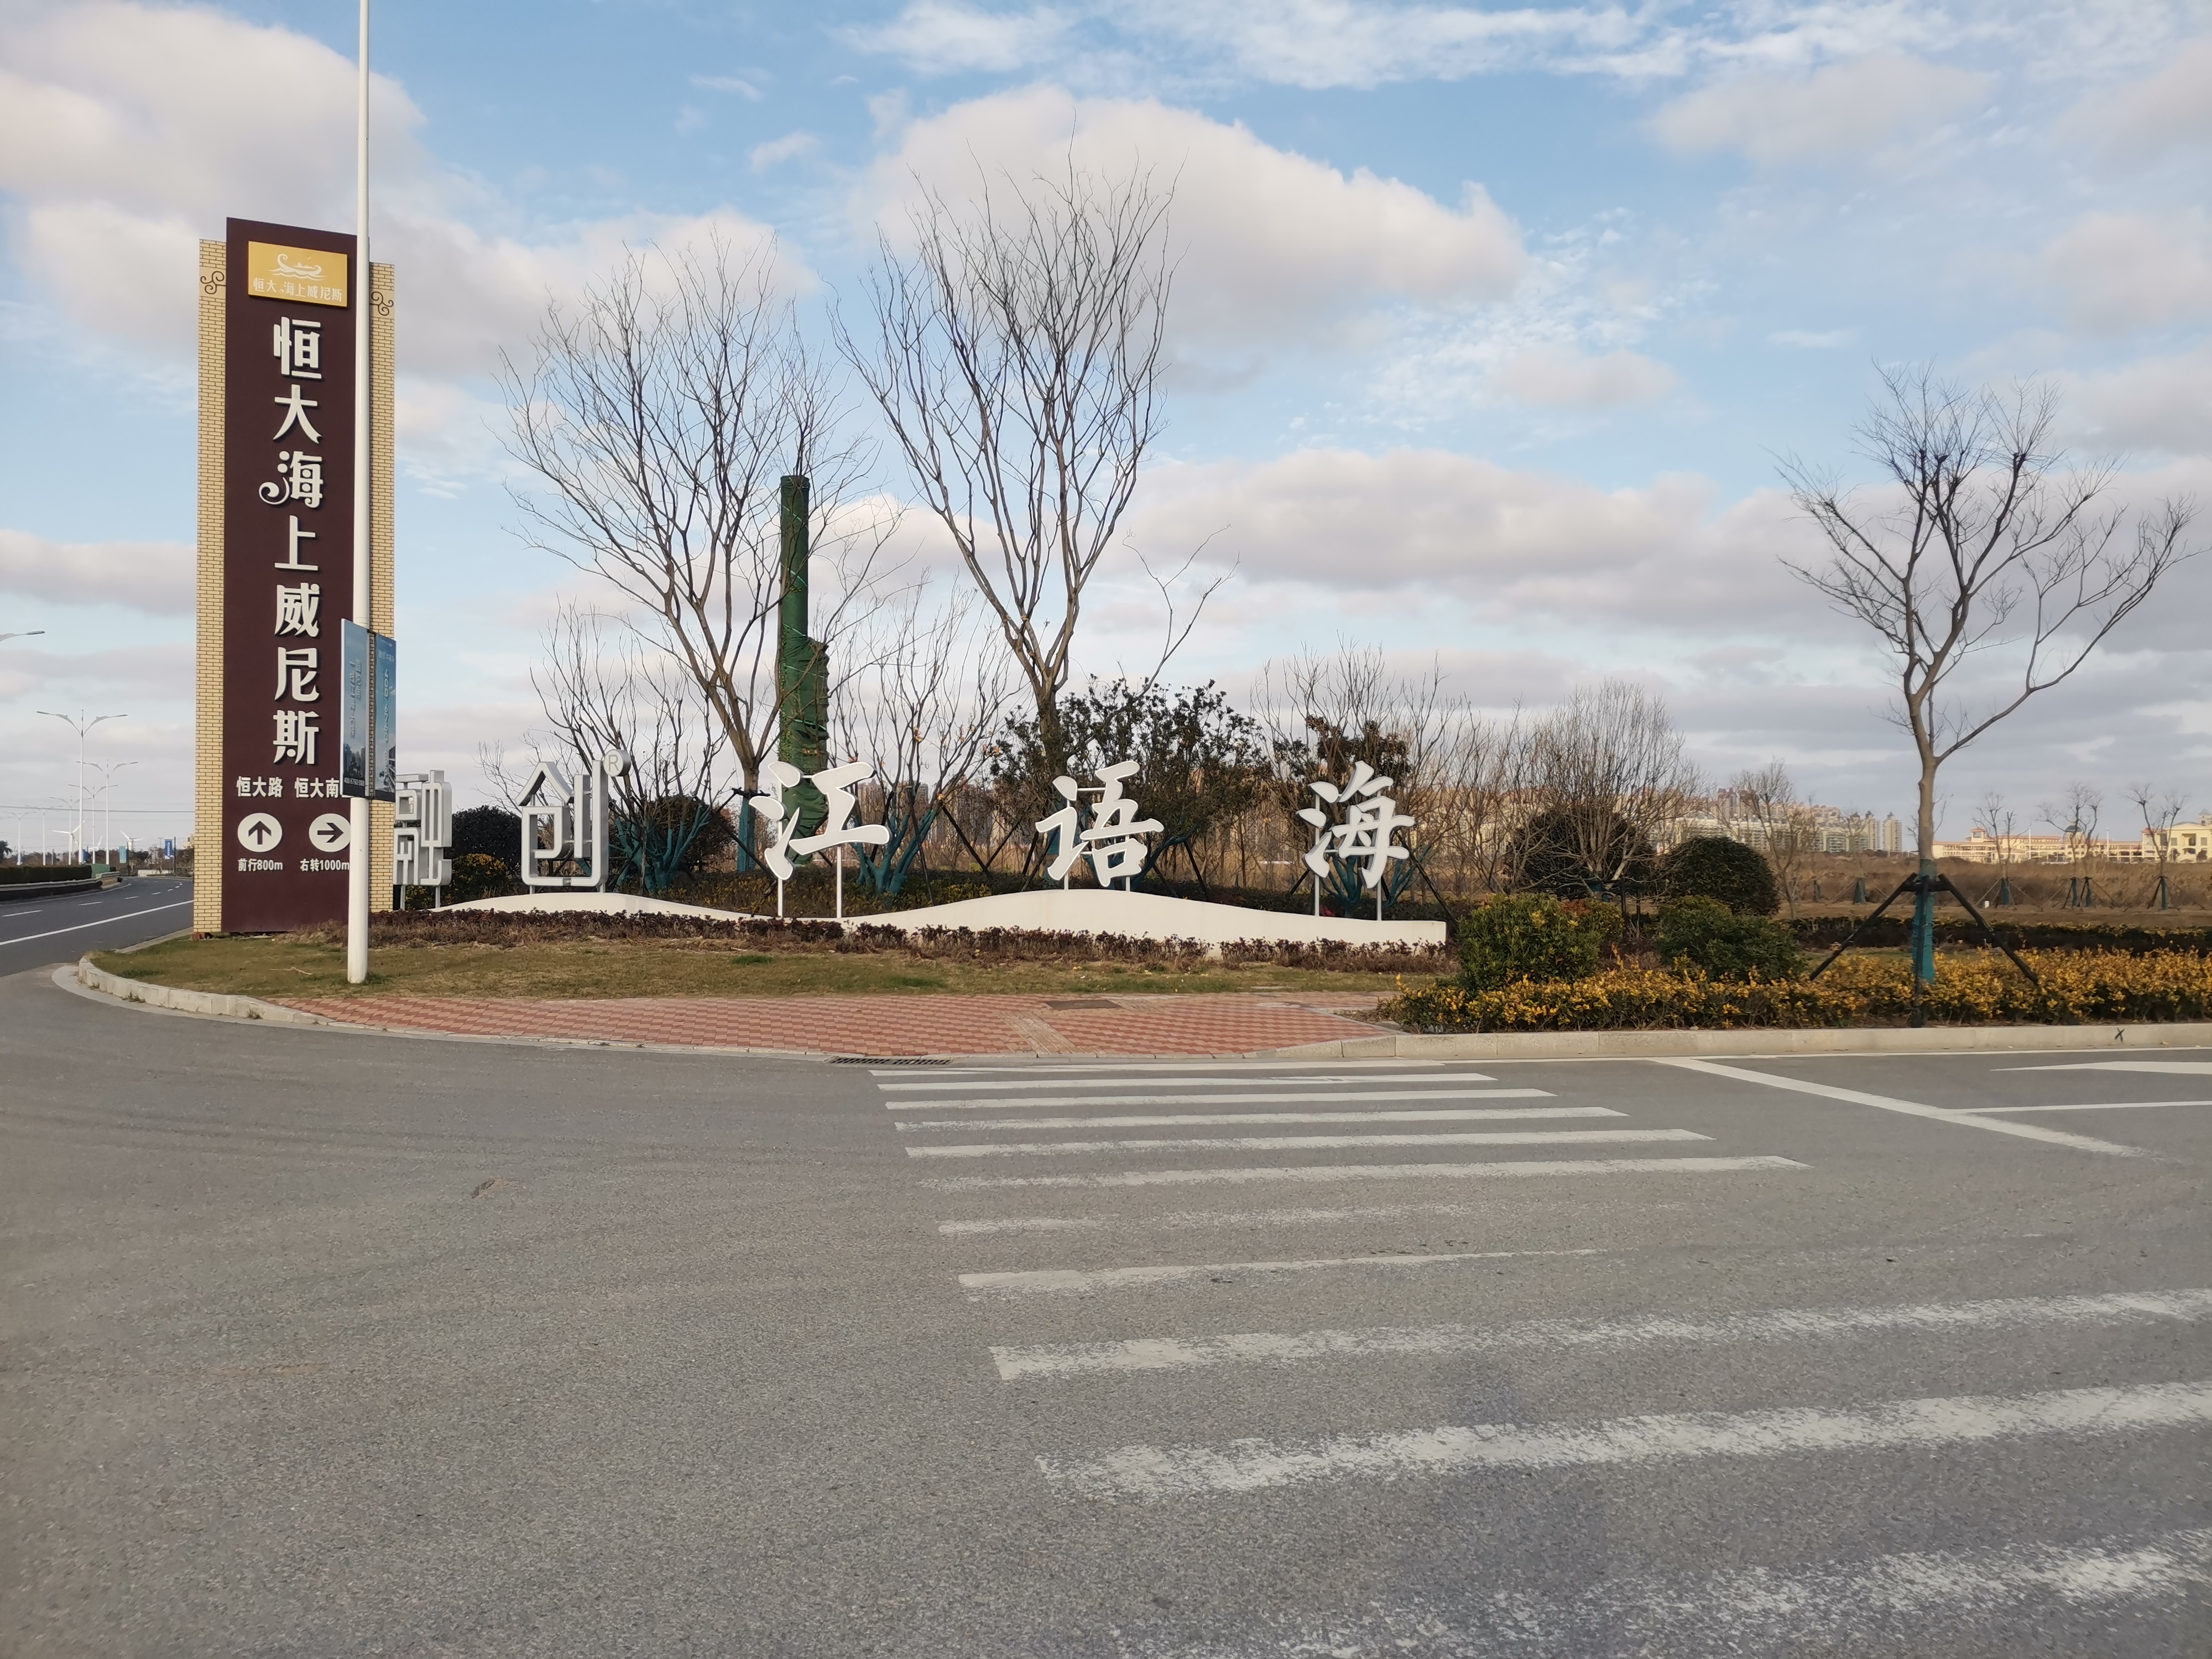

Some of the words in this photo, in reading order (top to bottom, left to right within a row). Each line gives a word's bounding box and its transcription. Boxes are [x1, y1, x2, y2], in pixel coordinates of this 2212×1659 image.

[259, 316, 324, 765] 恒大海上威尼斯
[236, 776, 283, 797] 恒大路
[238, 858, 283, 872] 前行800m
[300, 858, 350, 872] 右转1000m
